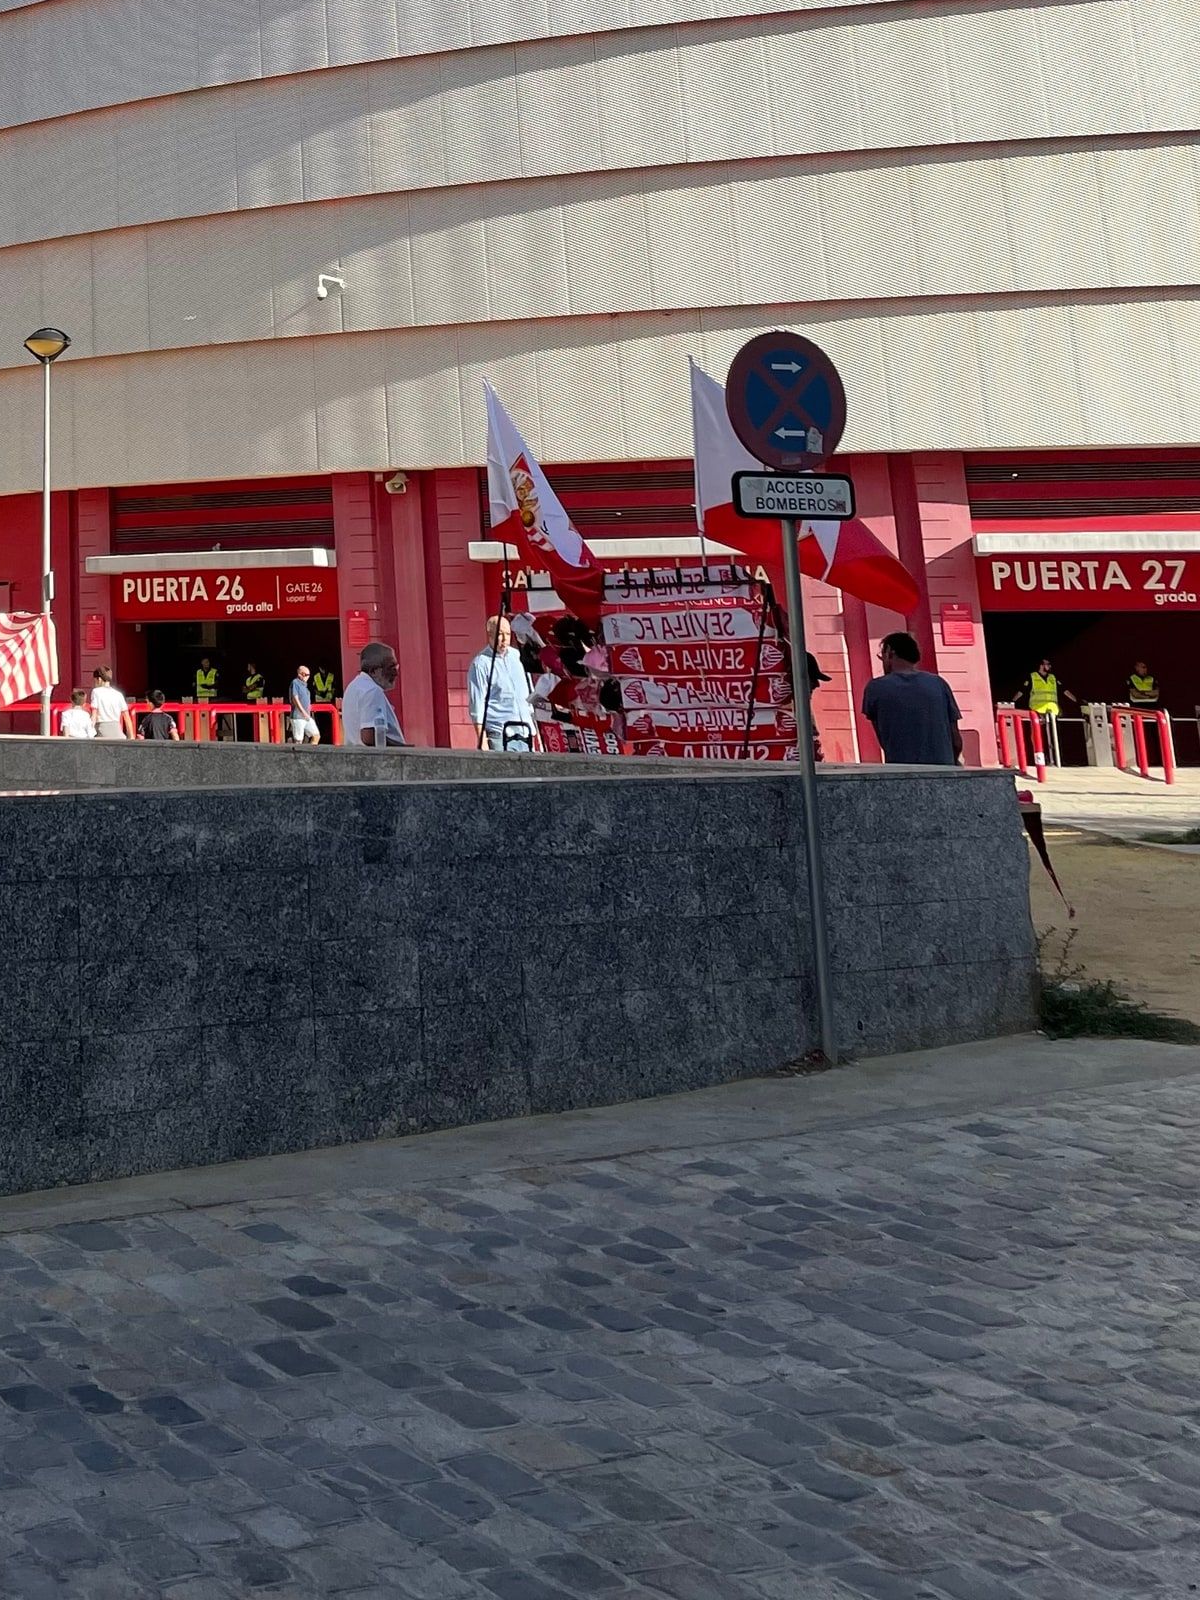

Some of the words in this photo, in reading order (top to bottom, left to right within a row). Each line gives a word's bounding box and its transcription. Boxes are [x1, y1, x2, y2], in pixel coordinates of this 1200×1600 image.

[766, 481, 824, 495] ACCESO
[756, 496, 837, 512] BOMBEROS
[991, 560, 1132, 591] PUERTA
[1141, 559, 1186, 591] 27
[123, 575, 209, 603] PUERTA
[215, 574, 245, 602] 26
[285, 582, 310, 594] GATE
[311, 582, 323, 593] 26
[1154, 590, 1198, 606] grada
[226, 601, 254, 615] grada
[255, 601, 273, 612] alta
